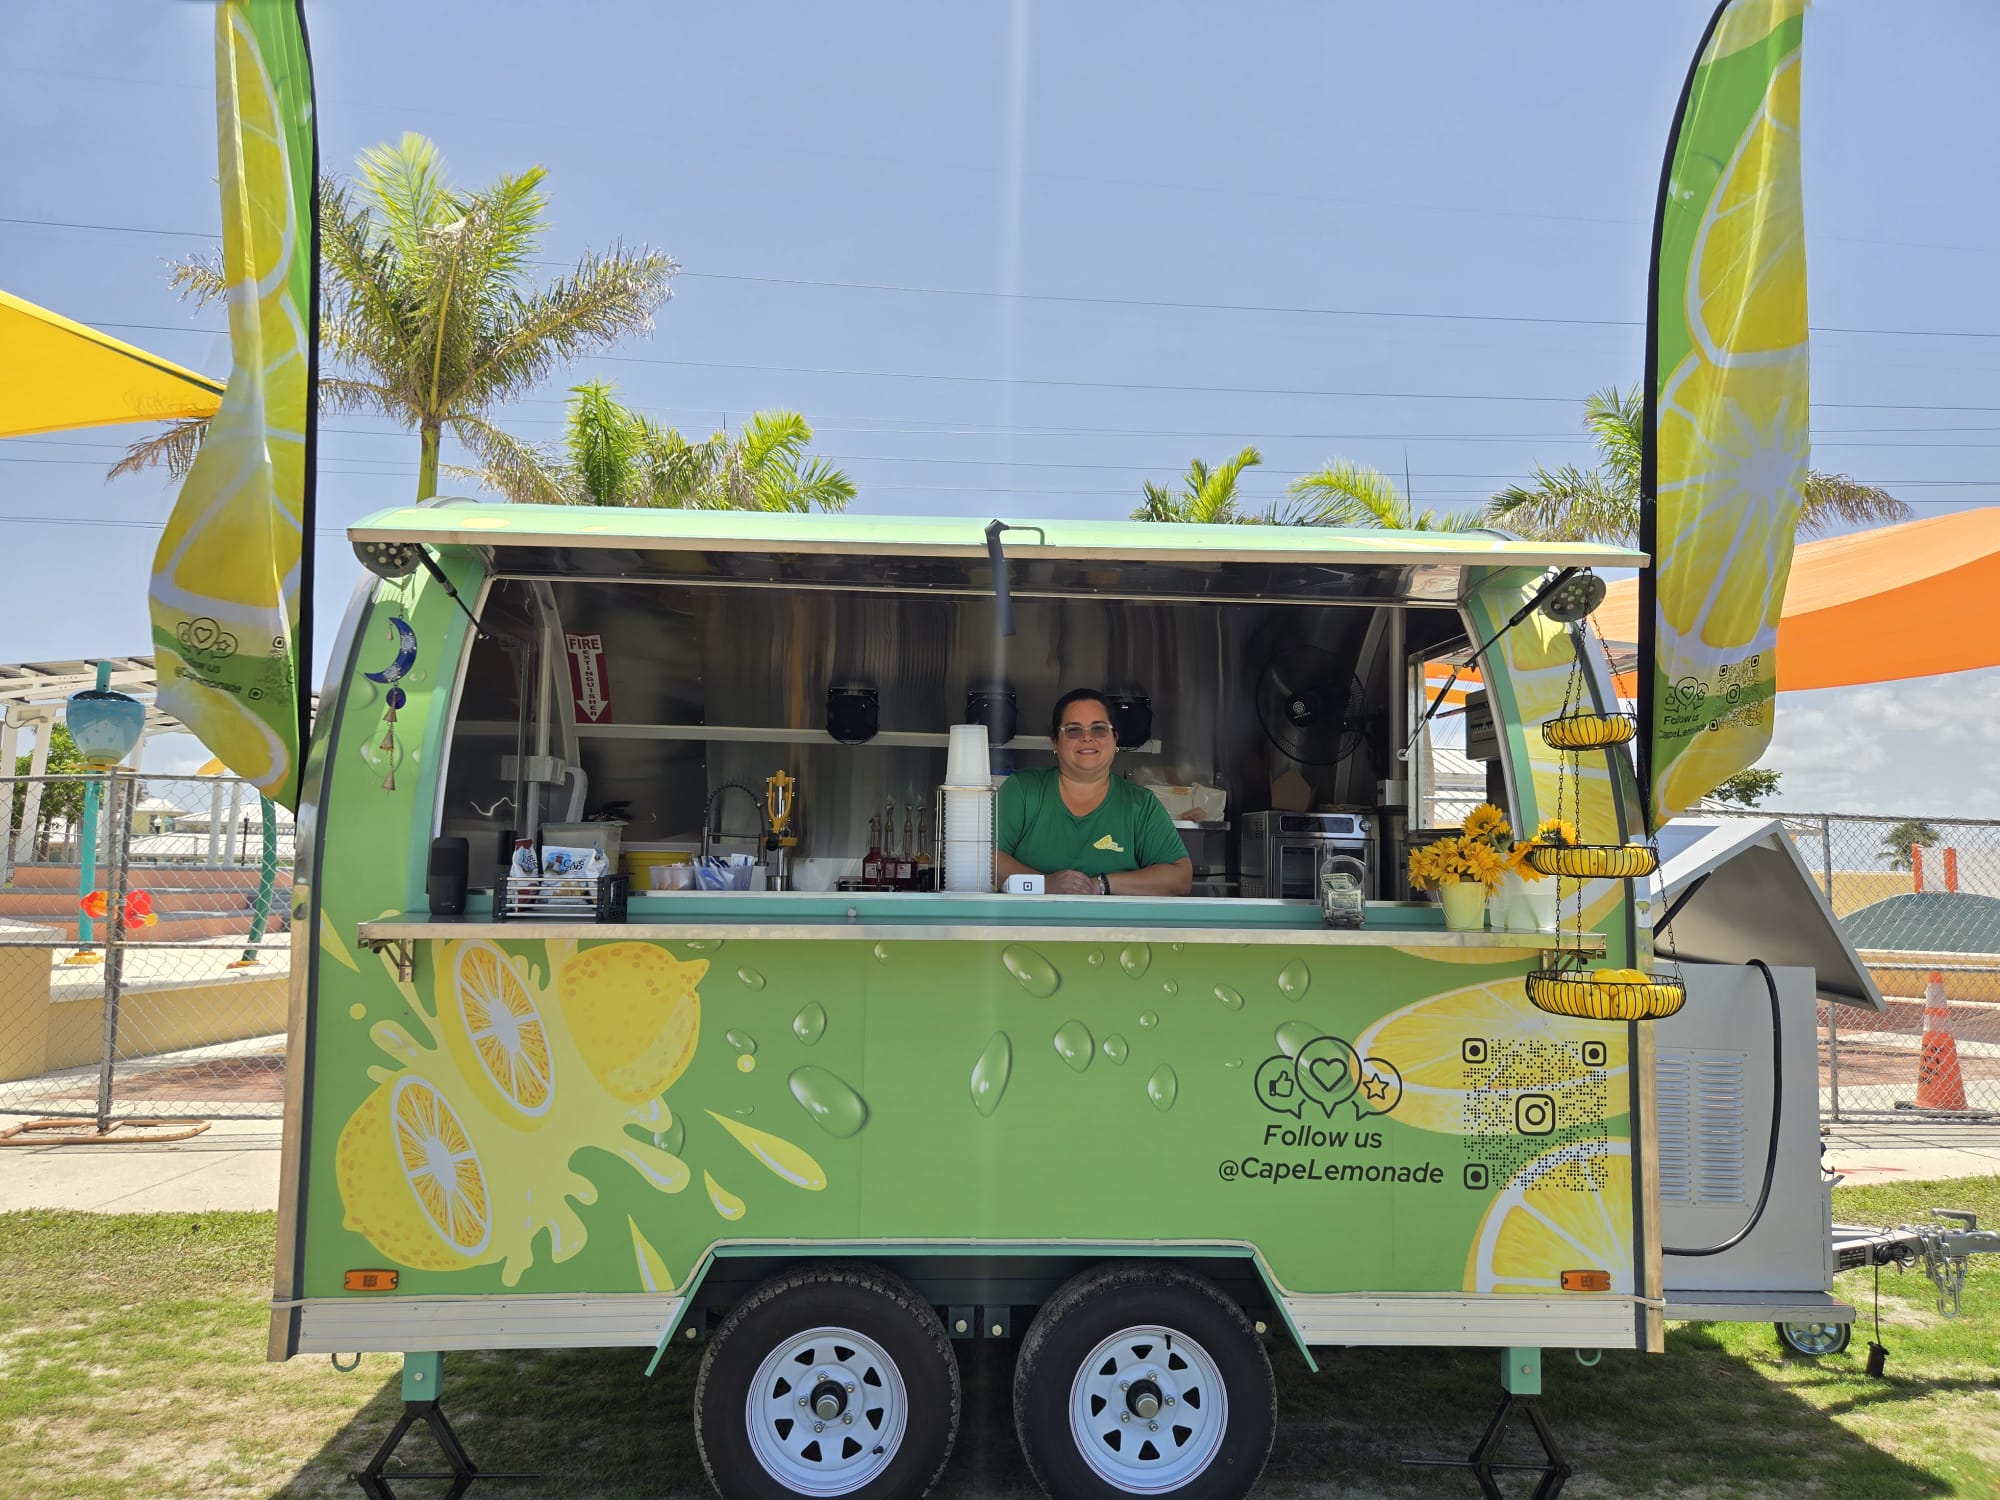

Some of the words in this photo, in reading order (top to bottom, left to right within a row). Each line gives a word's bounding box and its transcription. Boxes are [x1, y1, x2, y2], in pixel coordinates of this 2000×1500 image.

[568, 638, 600, 650] FIRE
[583, 650, 597, 717] EXTINGUISHER
[1264, 1124, 1349, 1148] Follow
[1354, 1131, 1383, 1149] us
[1218, 1157, 1444, 1185] @CapeLemonade
